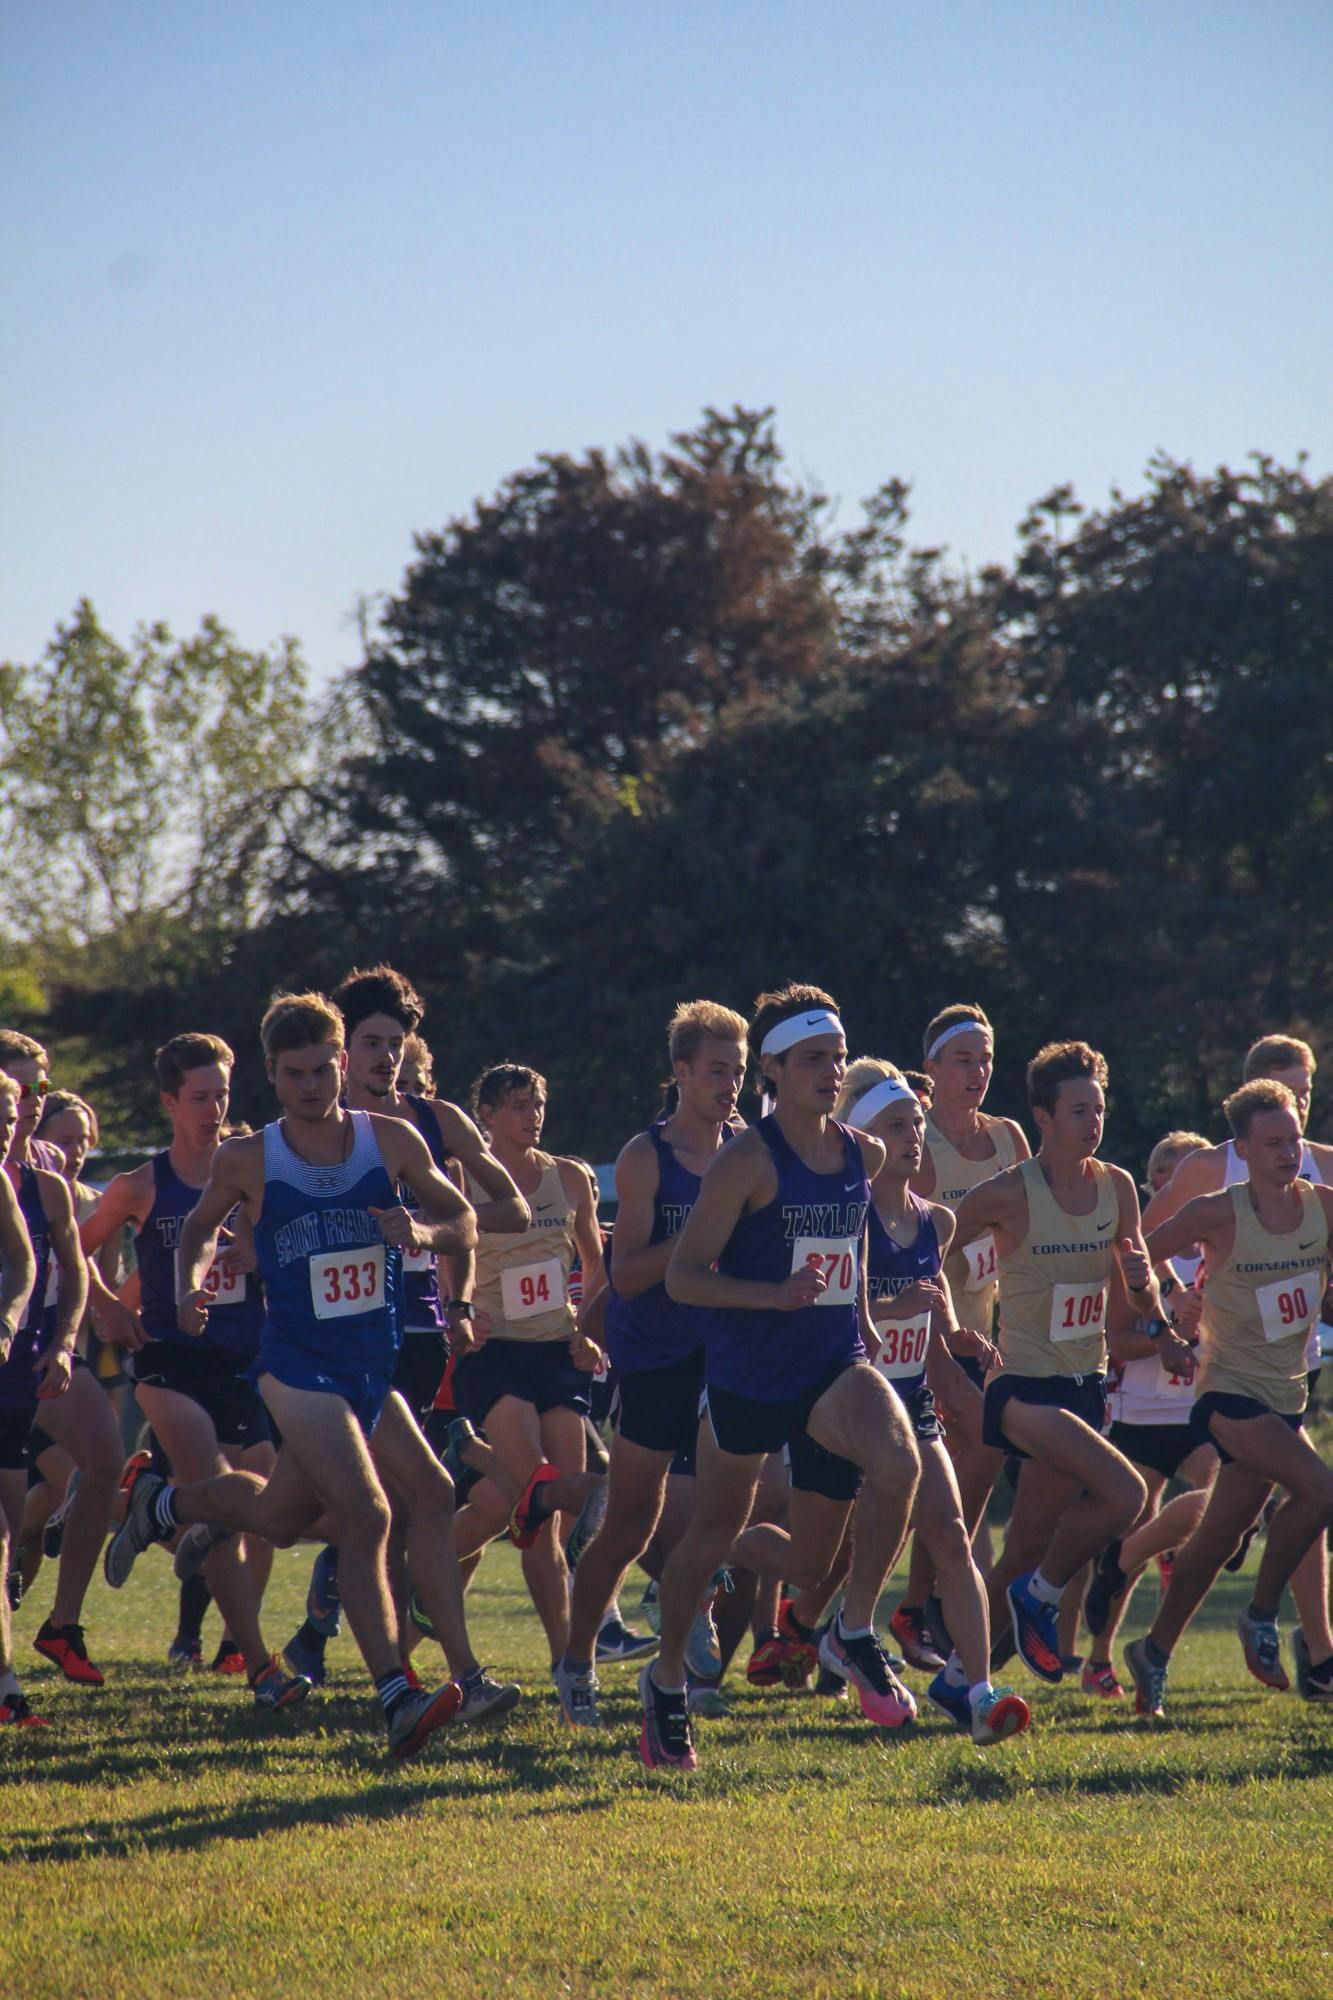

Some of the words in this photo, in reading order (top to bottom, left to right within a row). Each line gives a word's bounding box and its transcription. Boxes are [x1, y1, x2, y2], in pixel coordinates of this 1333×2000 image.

[274, 1211, 320, 1268] SAINT
[323, 1261, 376, 1304] 333
[520, 1273, 550, 1306] 94
[1062, 1291, 1104, 1328] 109
[1278, 1287, 1308, 1325] 90
[882, 1325, 927, 1365] 360
